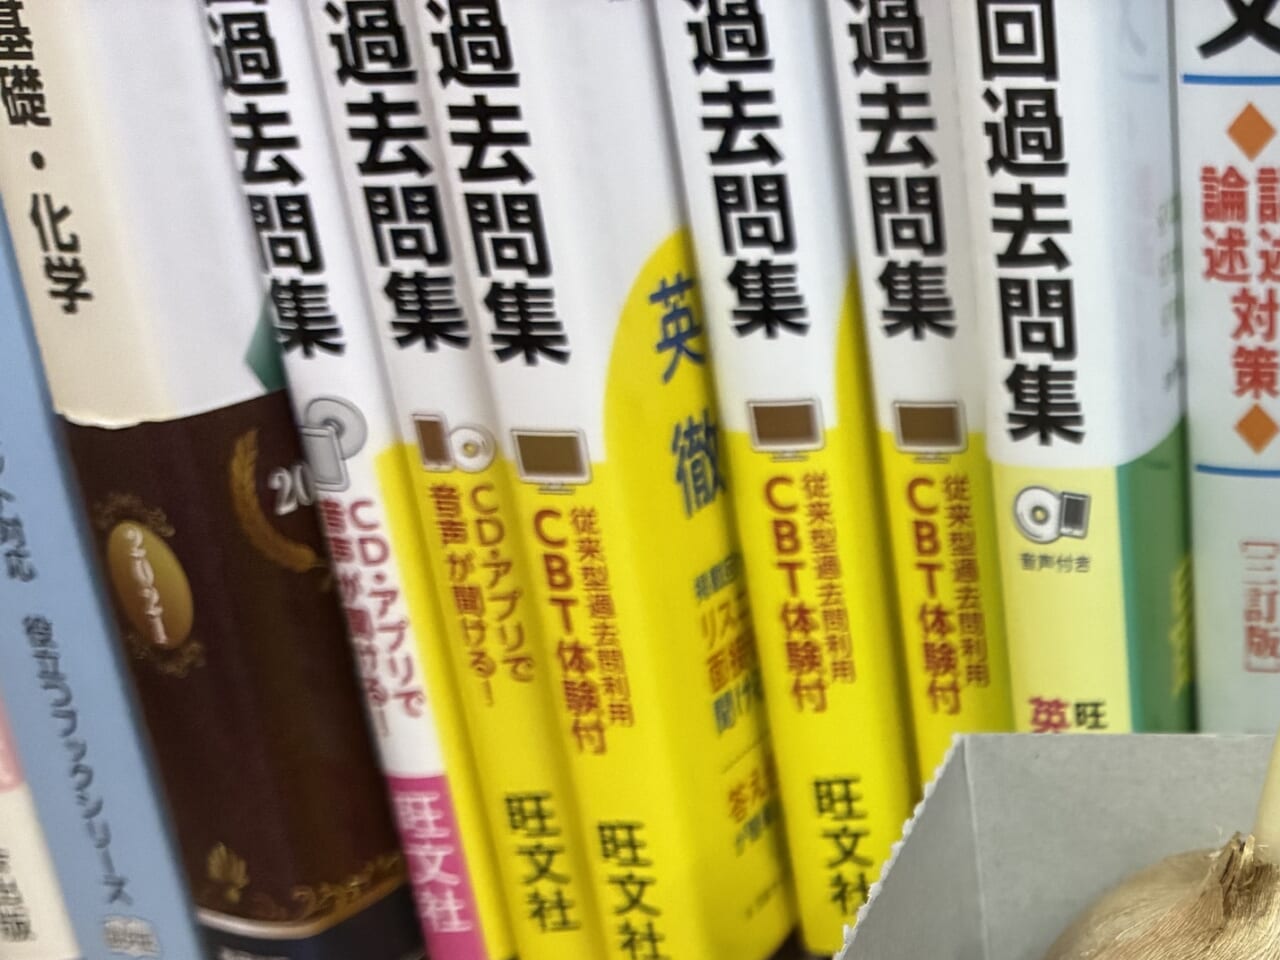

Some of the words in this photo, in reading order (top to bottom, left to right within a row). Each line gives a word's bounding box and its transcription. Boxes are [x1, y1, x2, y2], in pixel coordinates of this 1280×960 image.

[325, 0, 470, 352] 過去問集
[427, 0, 571, 366] 過去問集
[683, 0, 810, 340] 過去問集
[845, 0, 957, 341] 過去問集
[976, 0, 1086, 446] 回過去問集
[1201, 167, 1253, 283] 論述
[1230, 288, 1280, 399] 対策
[397, 791, 472, 933] 旺文社
[505, 790, 581, 932] 旺文社
